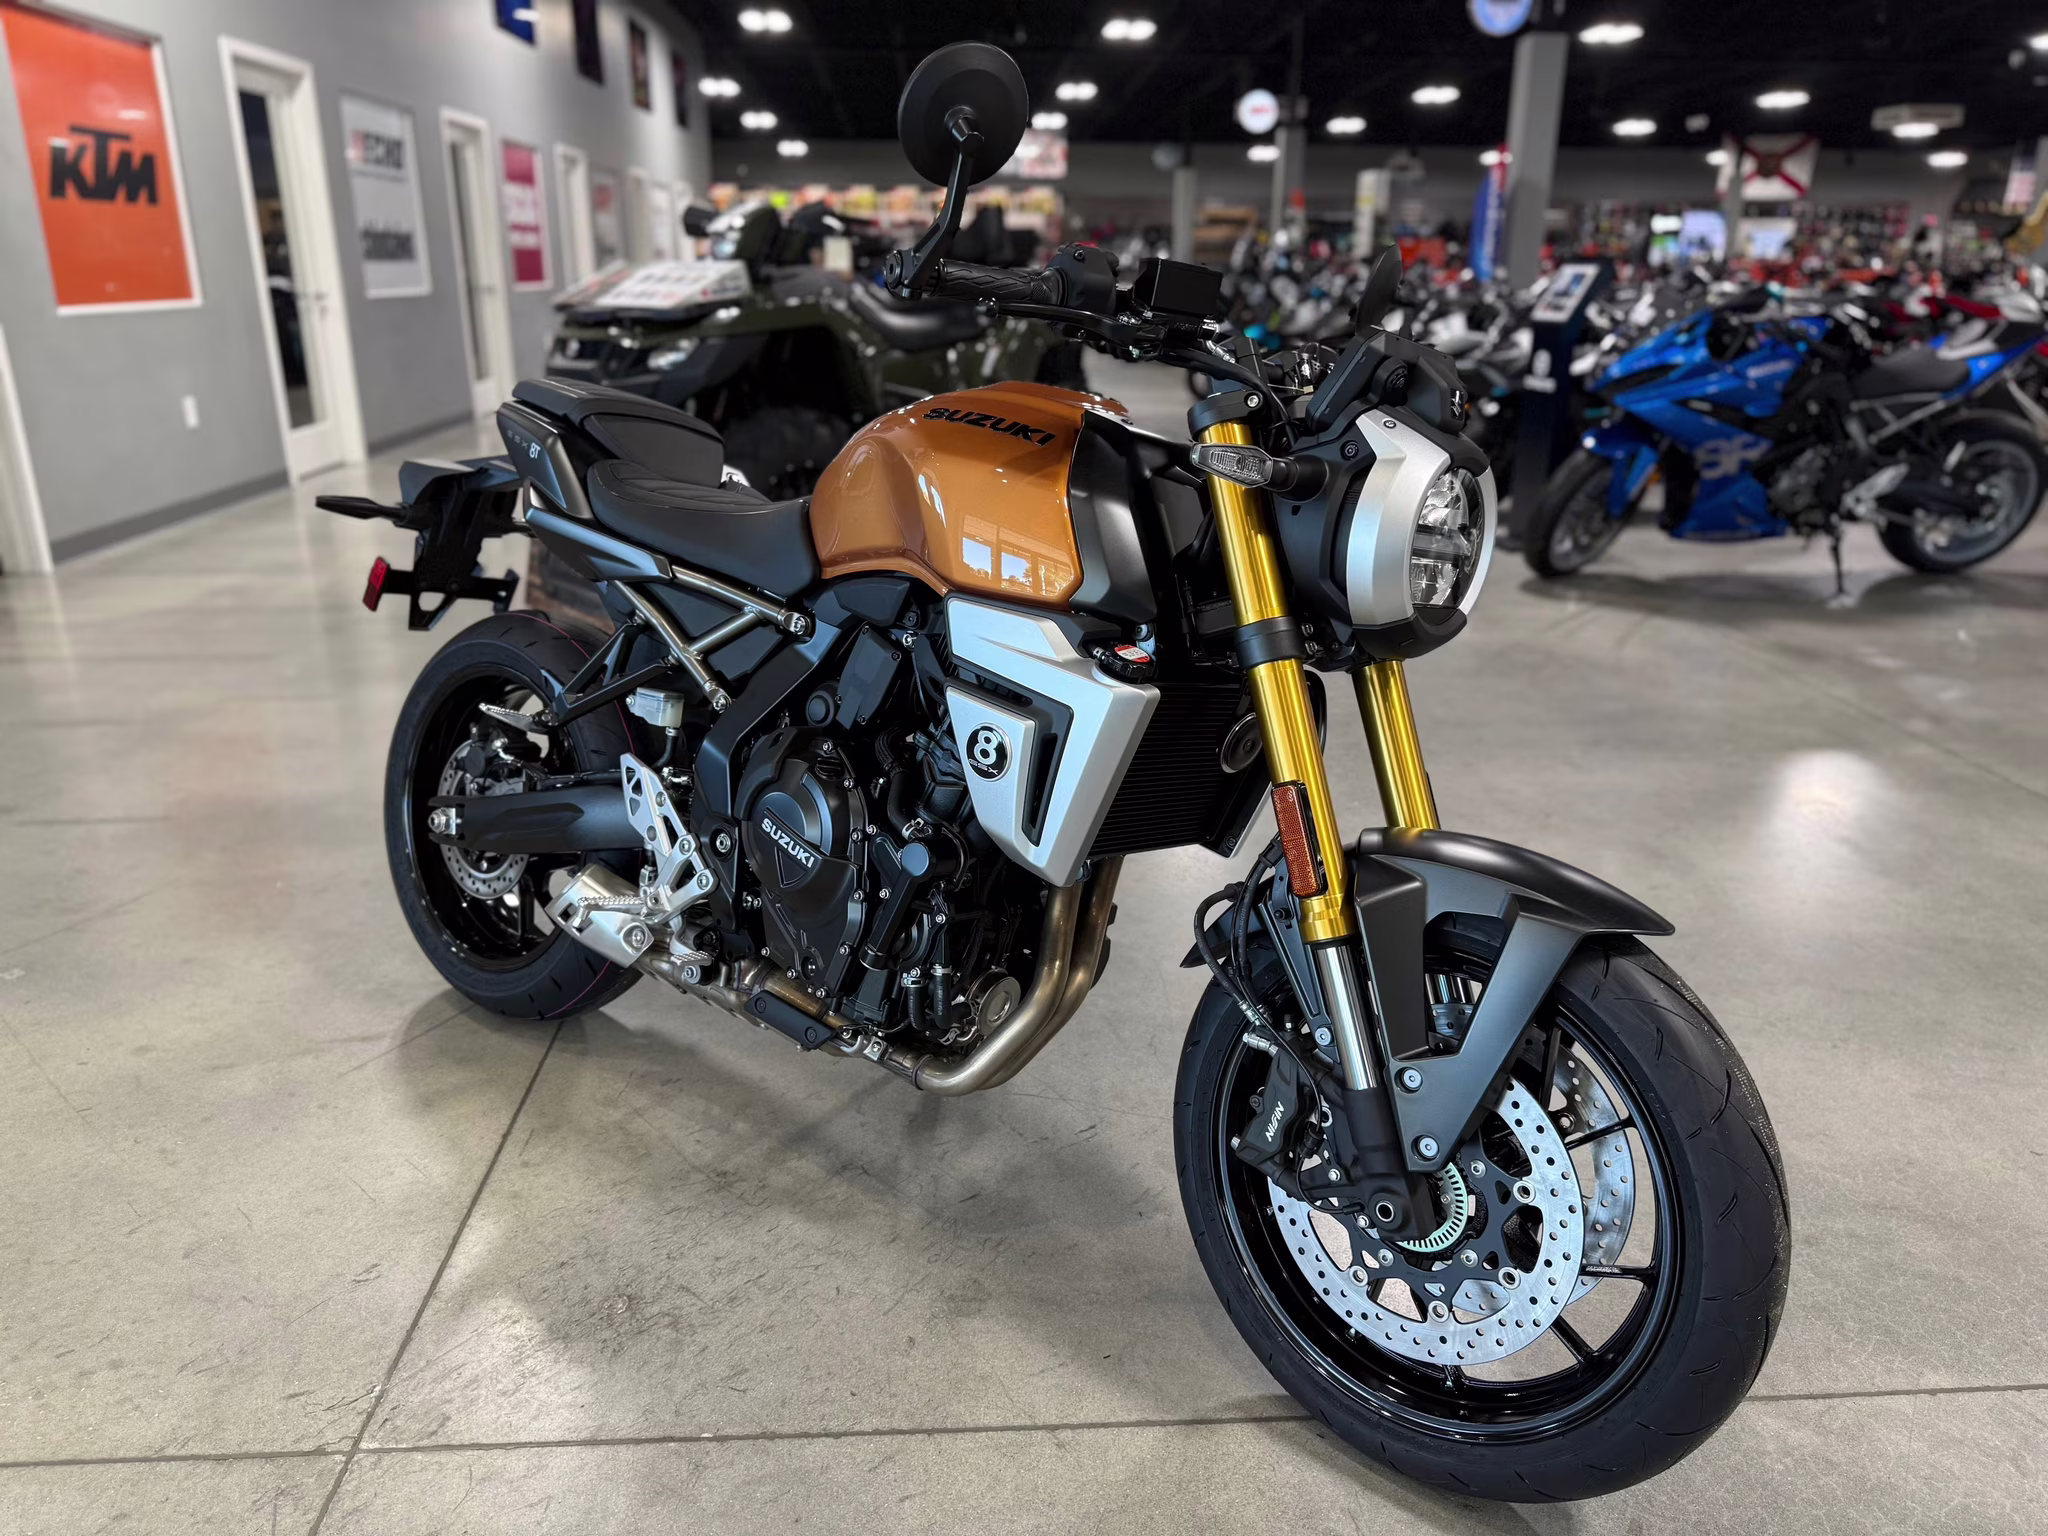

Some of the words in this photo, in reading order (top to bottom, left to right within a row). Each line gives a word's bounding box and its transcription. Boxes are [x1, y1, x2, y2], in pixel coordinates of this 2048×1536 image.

[50, 125, 158, 204] KTM
[922, 408, 1056, 446] SUZUKI
[529, 442, 541, 459] 8T
[973, 730, 998, 765] 8
[761, 818, 815, 868] SUZUKI
